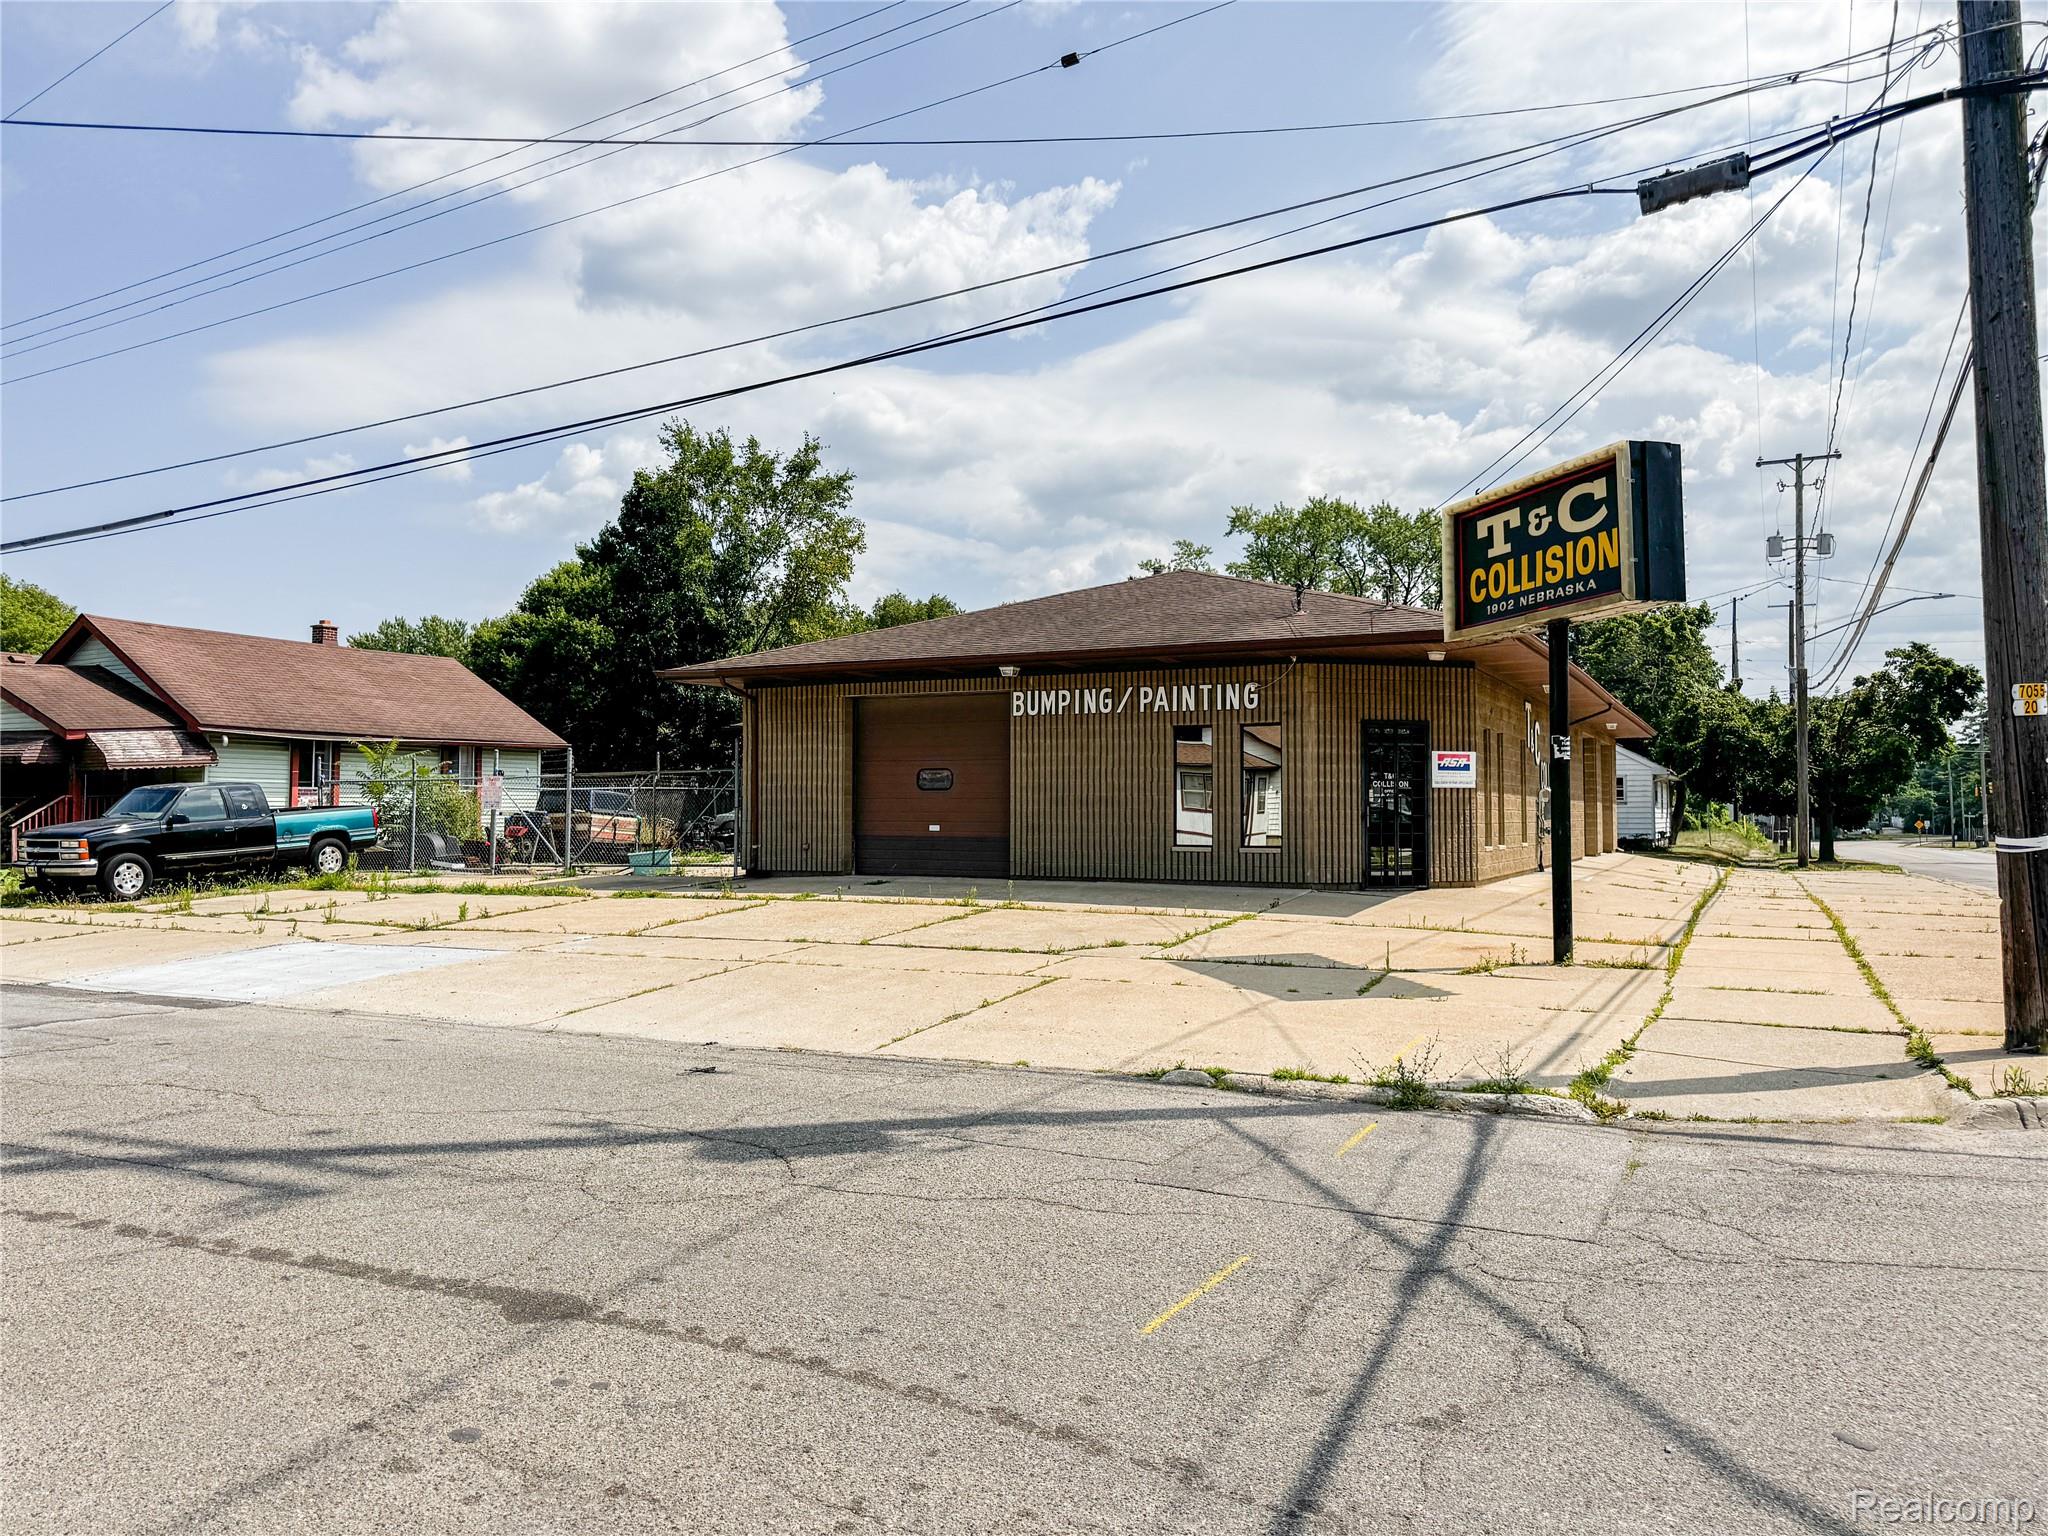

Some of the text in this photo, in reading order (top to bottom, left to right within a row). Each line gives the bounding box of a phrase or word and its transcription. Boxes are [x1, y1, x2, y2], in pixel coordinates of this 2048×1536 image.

[1470, 527, 1619, 603] COLLISION
[1486, 578, 1597, 616] 1902 NEBRASKA
[2019, 684, 2045, 699] 7055
[2024, 700, 2038, 714] 20
